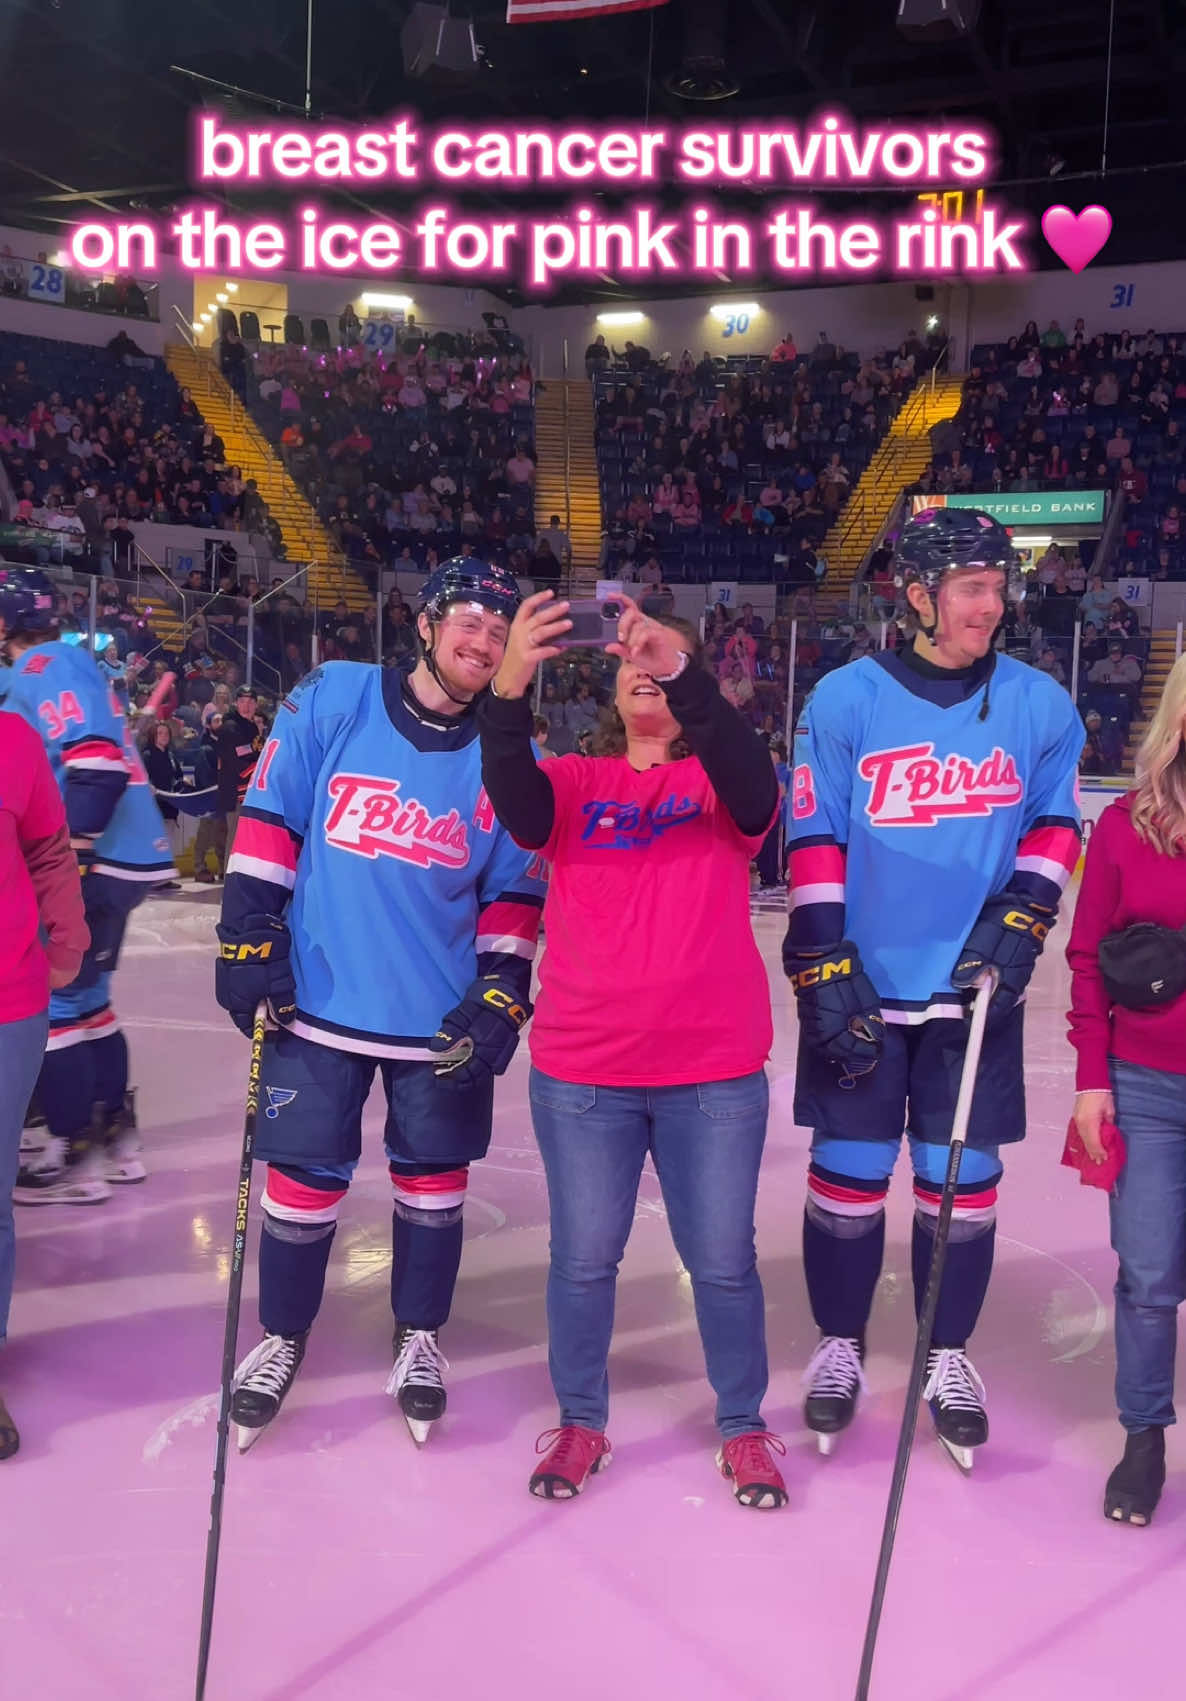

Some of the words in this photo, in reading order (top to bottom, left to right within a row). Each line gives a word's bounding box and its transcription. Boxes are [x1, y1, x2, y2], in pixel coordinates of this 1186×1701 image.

[31, 264, 63, 294] 28
[1109, 283, 1135, 309] 31
[364, 321, 394, 346] 29
[722, 313, 750, 338] 30
[950, 503, 1042, 514] TFIELD
[1051, 502, 1097, 513] BANK
[1125, 584, 1141, 600] 31
[38, 690, 86, 740] 34
[857, 741, 1022, 817] T-Birds
[324, 772, 470, 850] T-Birds
[471, 784, 497, 833] A
[235, 1177, 250, 1232] TACKS
